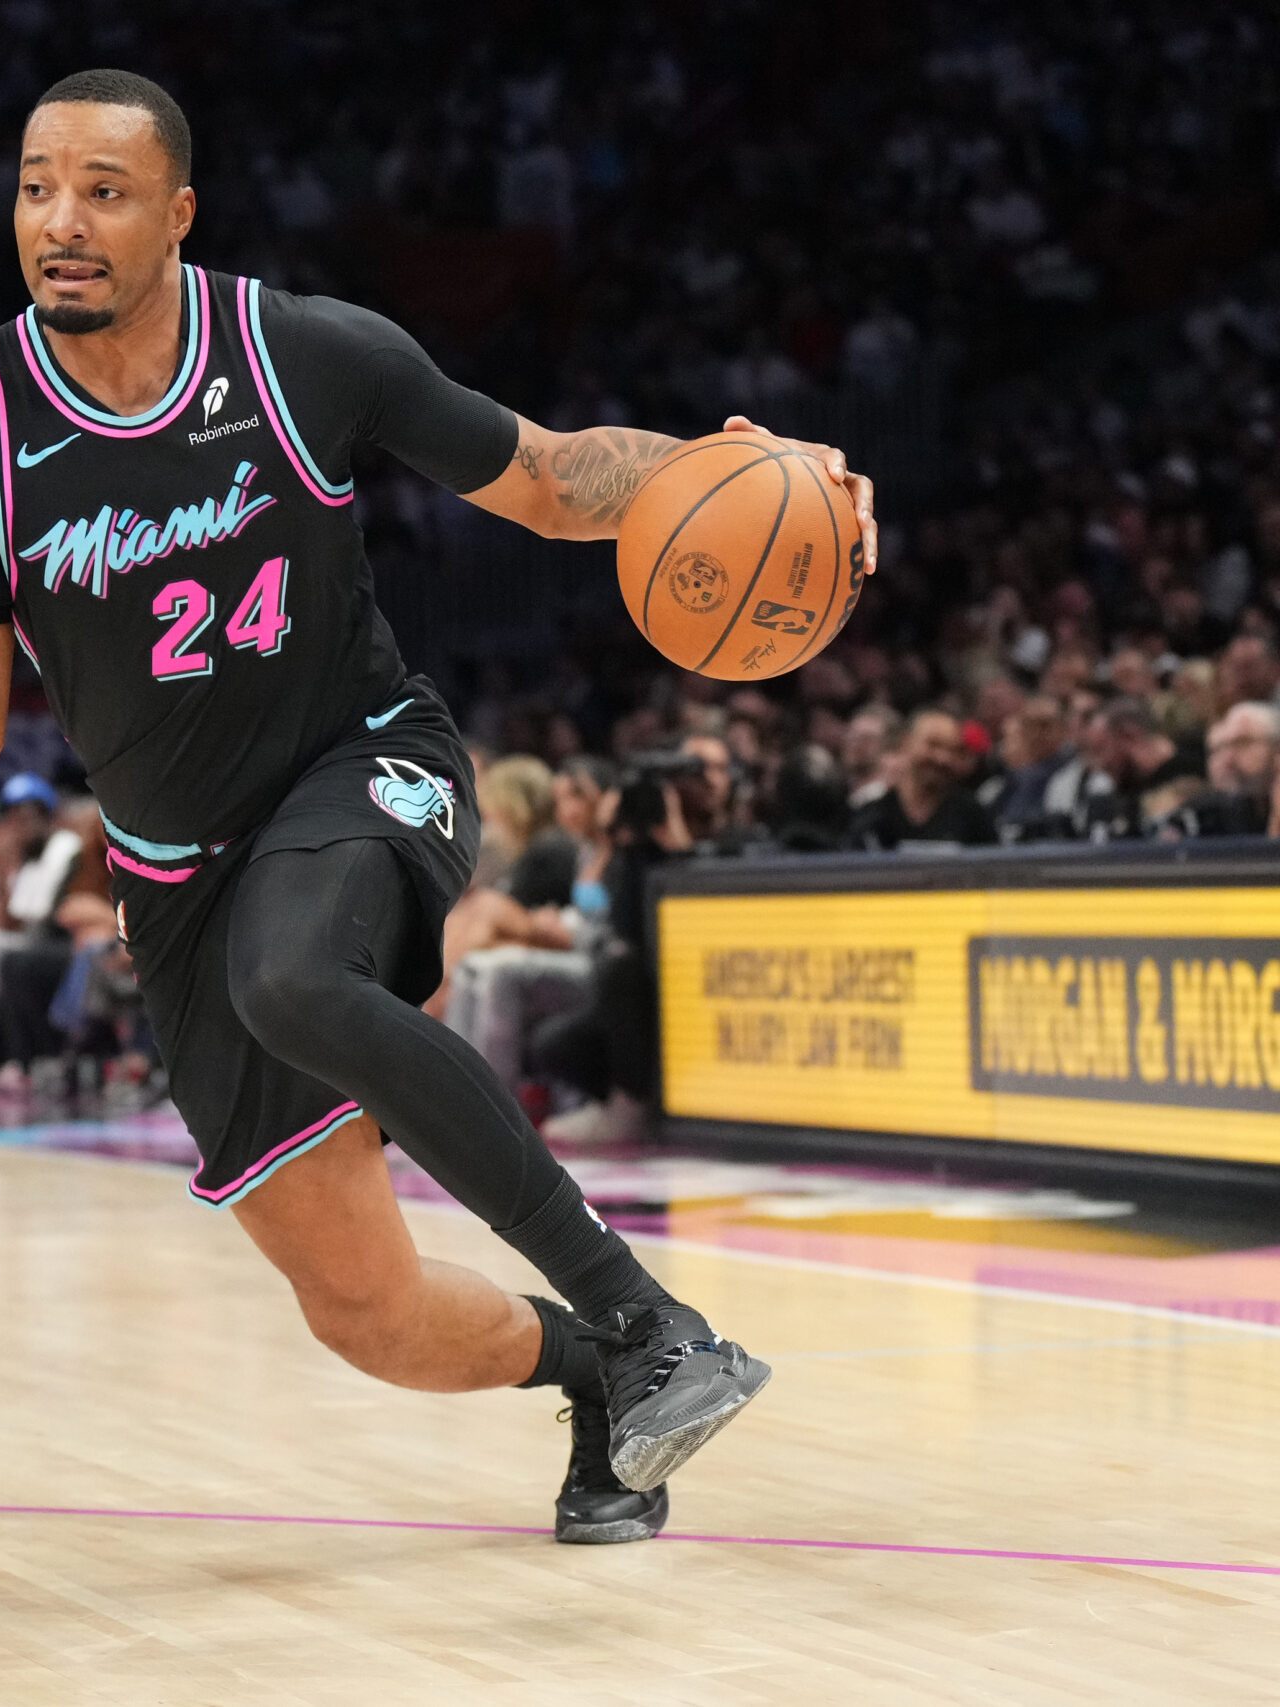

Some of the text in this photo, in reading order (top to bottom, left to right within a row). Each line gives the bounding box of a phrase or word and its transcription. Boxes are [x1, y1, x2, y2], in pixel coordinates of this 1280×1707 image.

[188, 414, 260, 446] Robinhood
[18, 459, 278, 600] Miami
[152, 556, 292, 682] 24
[979, 955, 1130, 1081] MORGAN
[1135, 956, 1168, 1083] &
